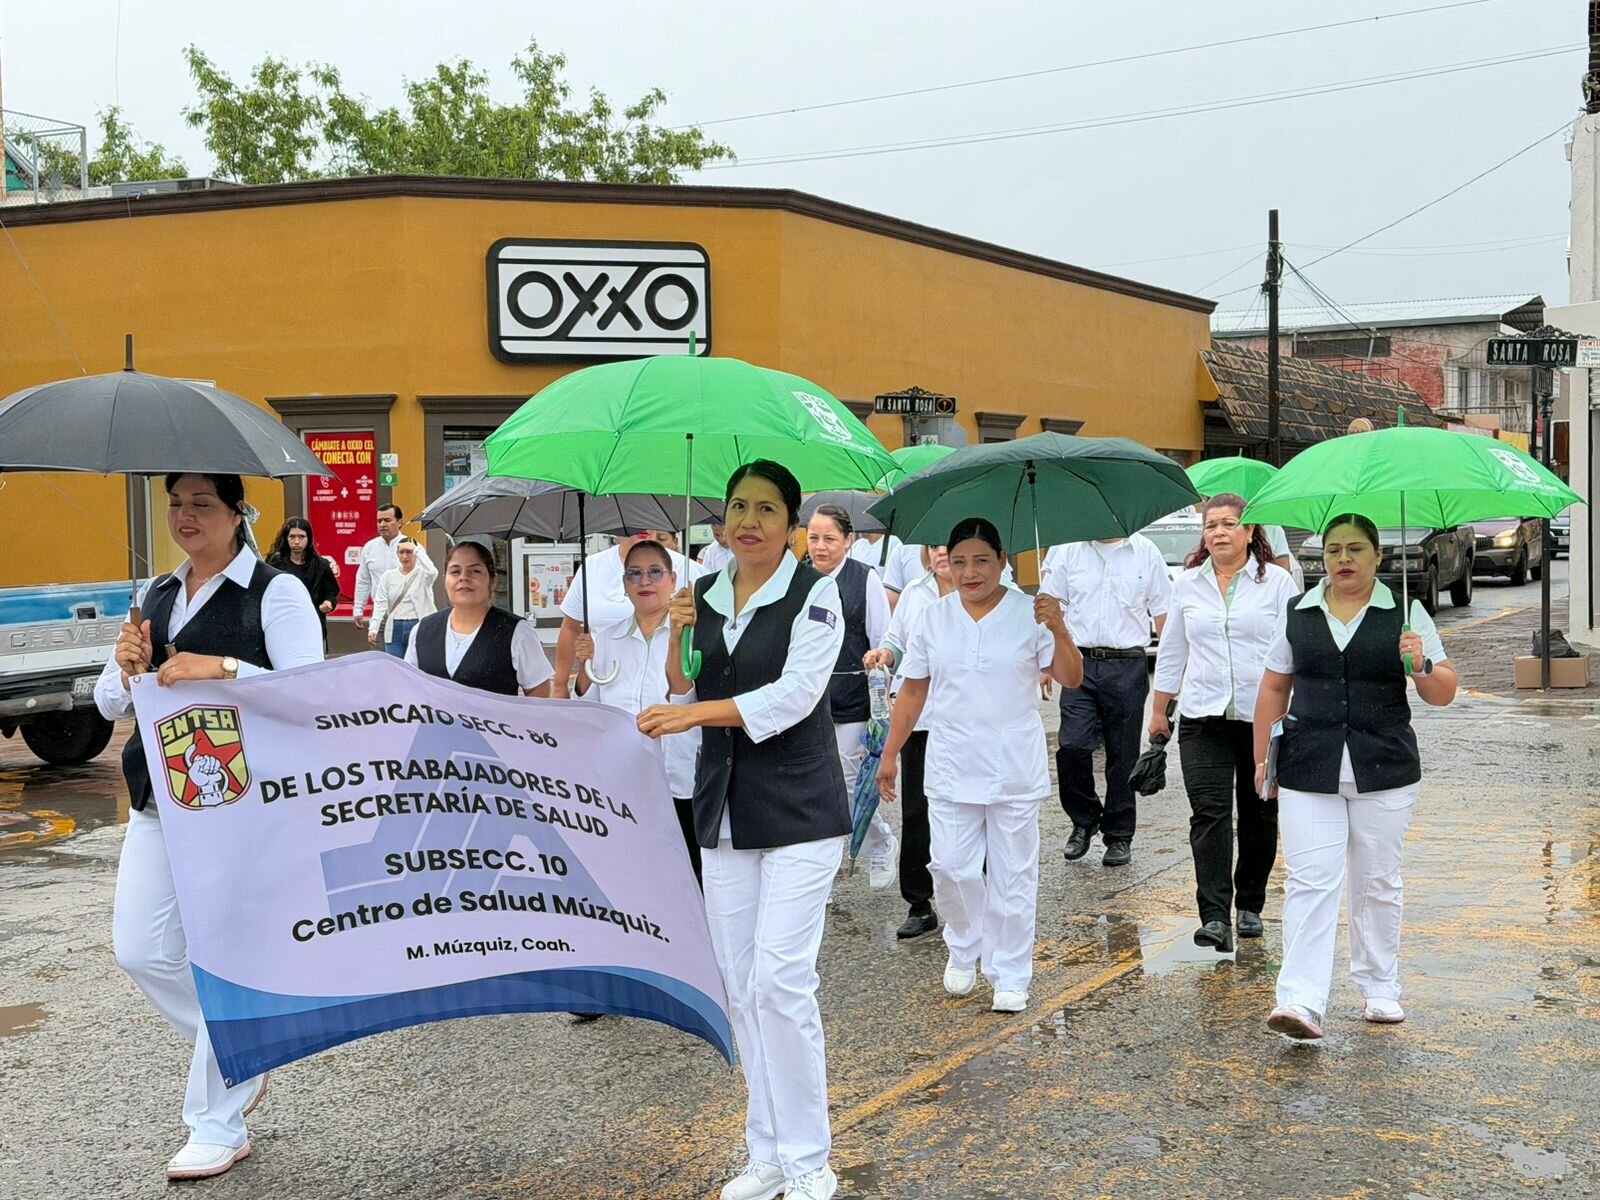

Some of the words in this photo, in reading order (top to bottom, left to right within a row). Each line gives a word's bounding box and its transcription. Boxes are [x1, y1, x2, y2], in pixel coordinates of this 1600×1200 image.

[506, 270, 699, 332] OXXO
[1493, 343, 1528, 361] SANTA
[1542, 343, 1571, 361] ROSA
[888, 398, 911, 411] SANTA
[915, 399, 933, 412] ROSA
[322, 451, 355, 465] CONECTA
[356, 451, 371, 465] CON
[341, 440, 346, 450] A
[364, 440, 375, 450] CEL
[160, 709, 235, 744] SNTSA
[314, 703, 455, 730] SINDICATO
[457, 713, 525, 741] SECC.
[528, 729, 558, 748] 86
[259, 776, 299, 804] DE
[305, 762, 365, 795] LOS
[368, 759, 571, 800] TRABAJADORES
[574, 783, 606, 810] DE
[607, 796, 639, 825] LA
[320, 785, 492, 827] SECRETARÍA
[494, 796, 528, 820] DE
[531, 802, 609, 838] SALUD
[384, 848, 535, 876] SUBSECC.
[538, 853, 568, 877] 10
[291, 901, 405, 943] Centro
[412, 892, 453, 917] de
[459, 889, 547, 914] Salud
[553, 896, 672, 944] Múzquiz.
[406, 945, 430, 961] M.
[433, 936, 518, 956] Múzquiz,
[521, 937, 577, 954] Coah.
